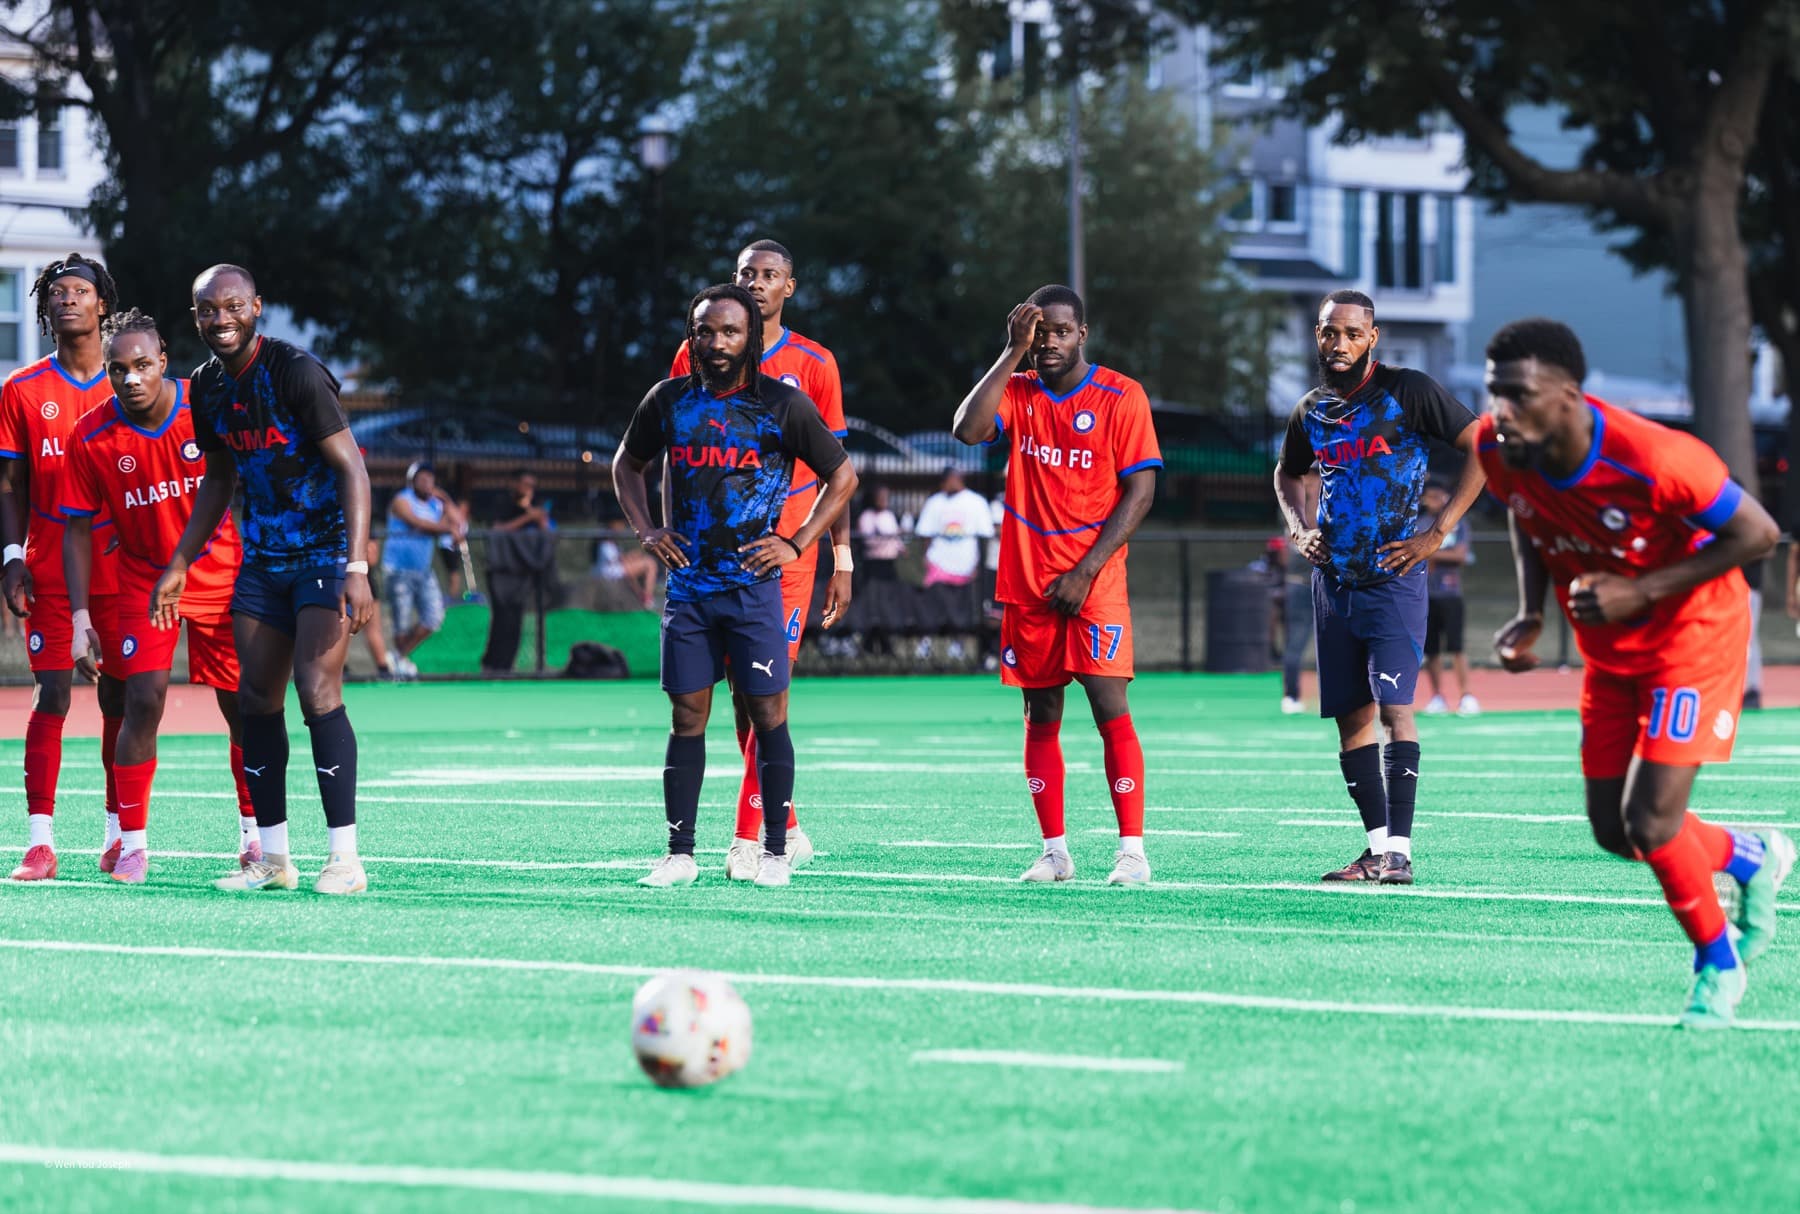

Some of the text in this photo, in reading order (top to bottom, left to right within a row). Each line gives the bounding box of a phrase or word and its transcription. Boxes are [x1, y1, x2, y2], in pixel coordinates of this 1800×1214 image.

[671, 445, 762, 468] PUMA
[1069, 448, 1093, 469] FC
[125, 480, 181, 509] ALASO
[785, 607, 801, 643] 6
[1088, 624, 1124, 661] 17
[1648, 686, 1701, 743] 10
